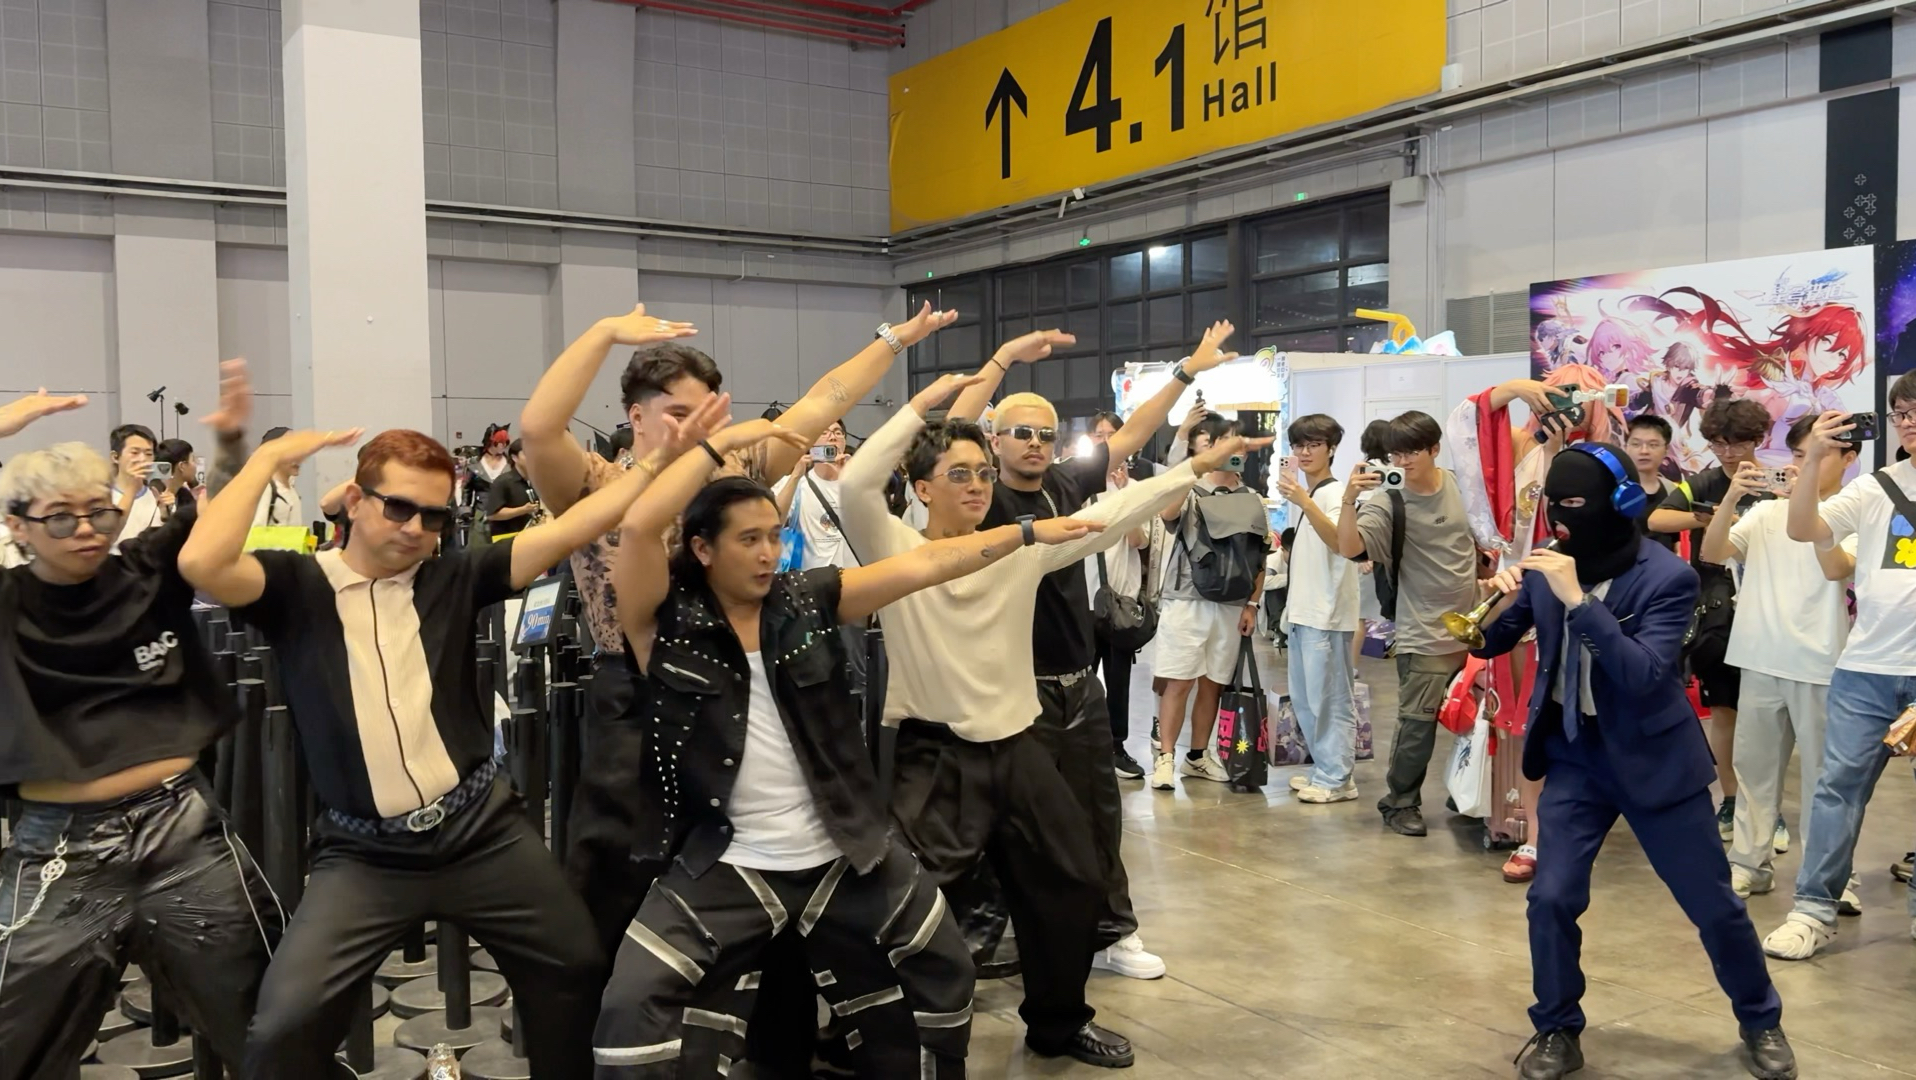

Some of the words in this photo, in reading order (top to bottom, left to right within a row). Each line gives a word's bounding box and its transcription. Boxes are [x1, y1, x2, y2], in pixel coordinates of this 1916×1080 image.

[1205, 0, 1267, 66] 馆
[1065, 16, 1185, 153] 4.1
[1203, 61, 1277, 122] Hall
